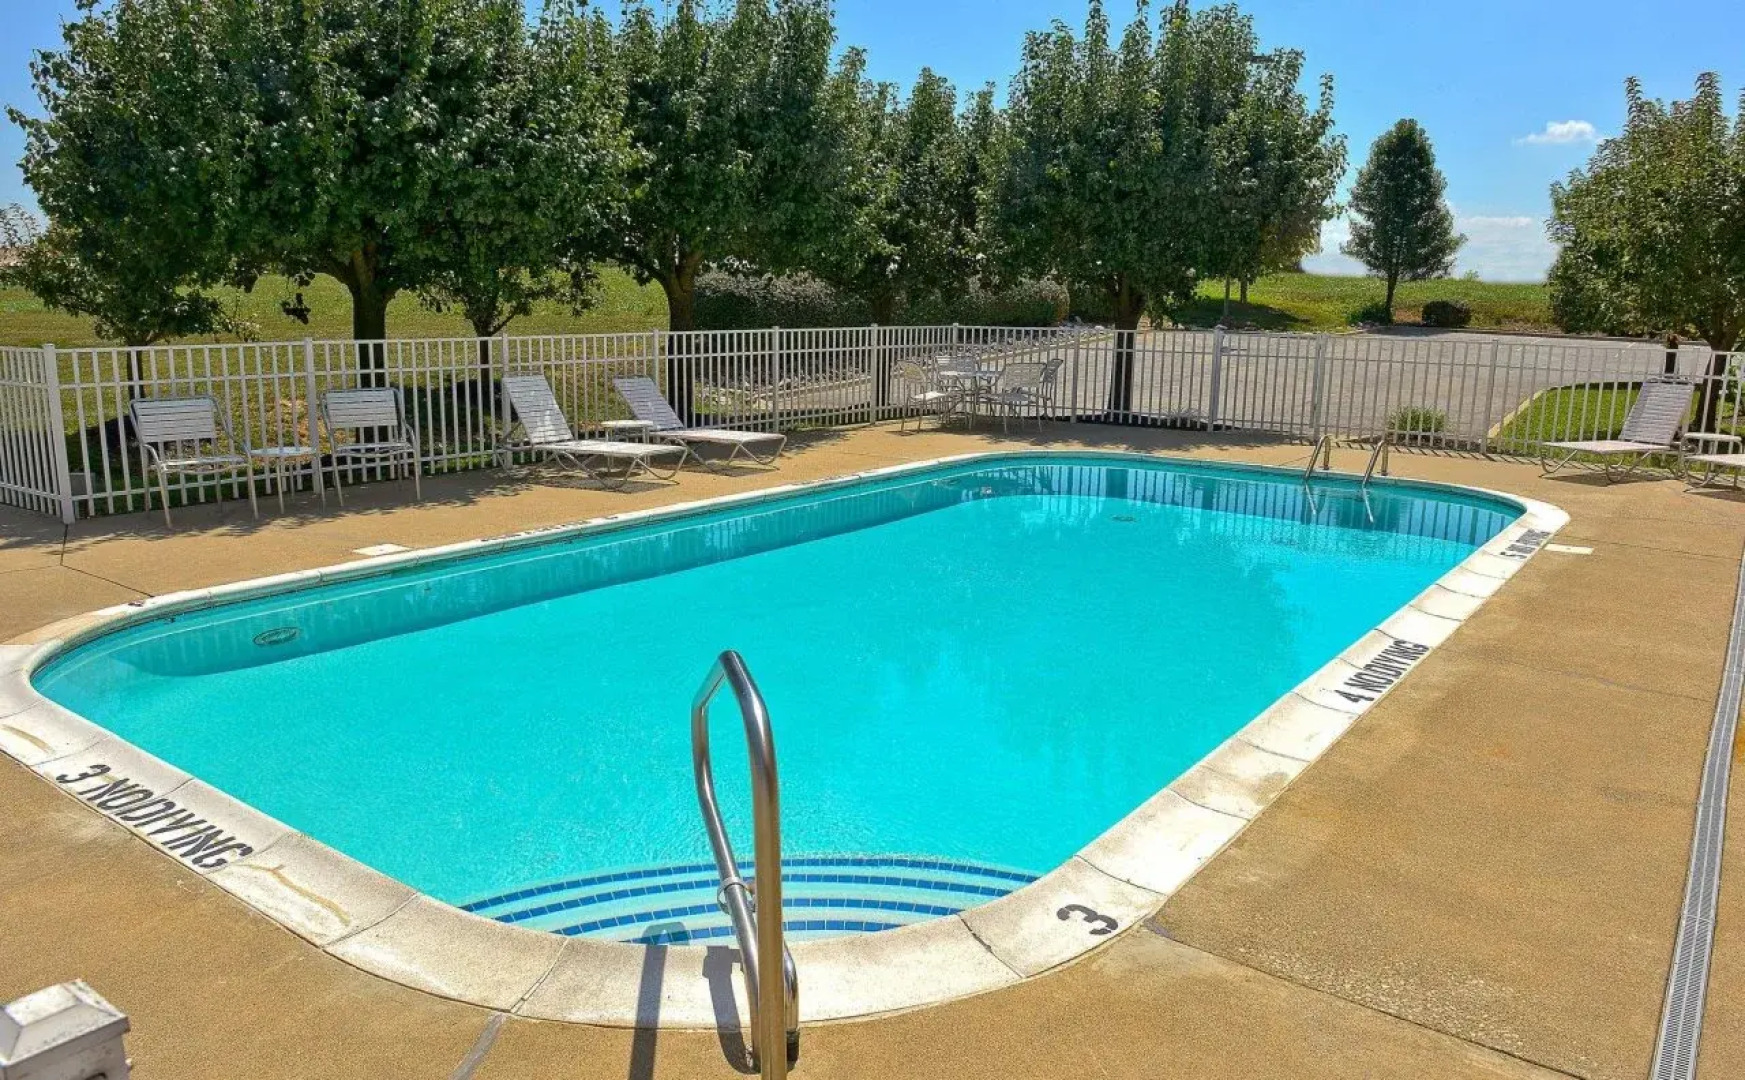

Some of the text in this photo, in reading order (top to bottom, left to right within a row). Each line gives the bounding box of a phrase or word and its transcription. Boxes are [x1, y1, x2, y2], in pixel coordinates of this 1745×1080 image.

[1333, 689, 1375, 703] 4
[56, 764, 111, 784] 3
[1056, 904, 1118, 935] 3
